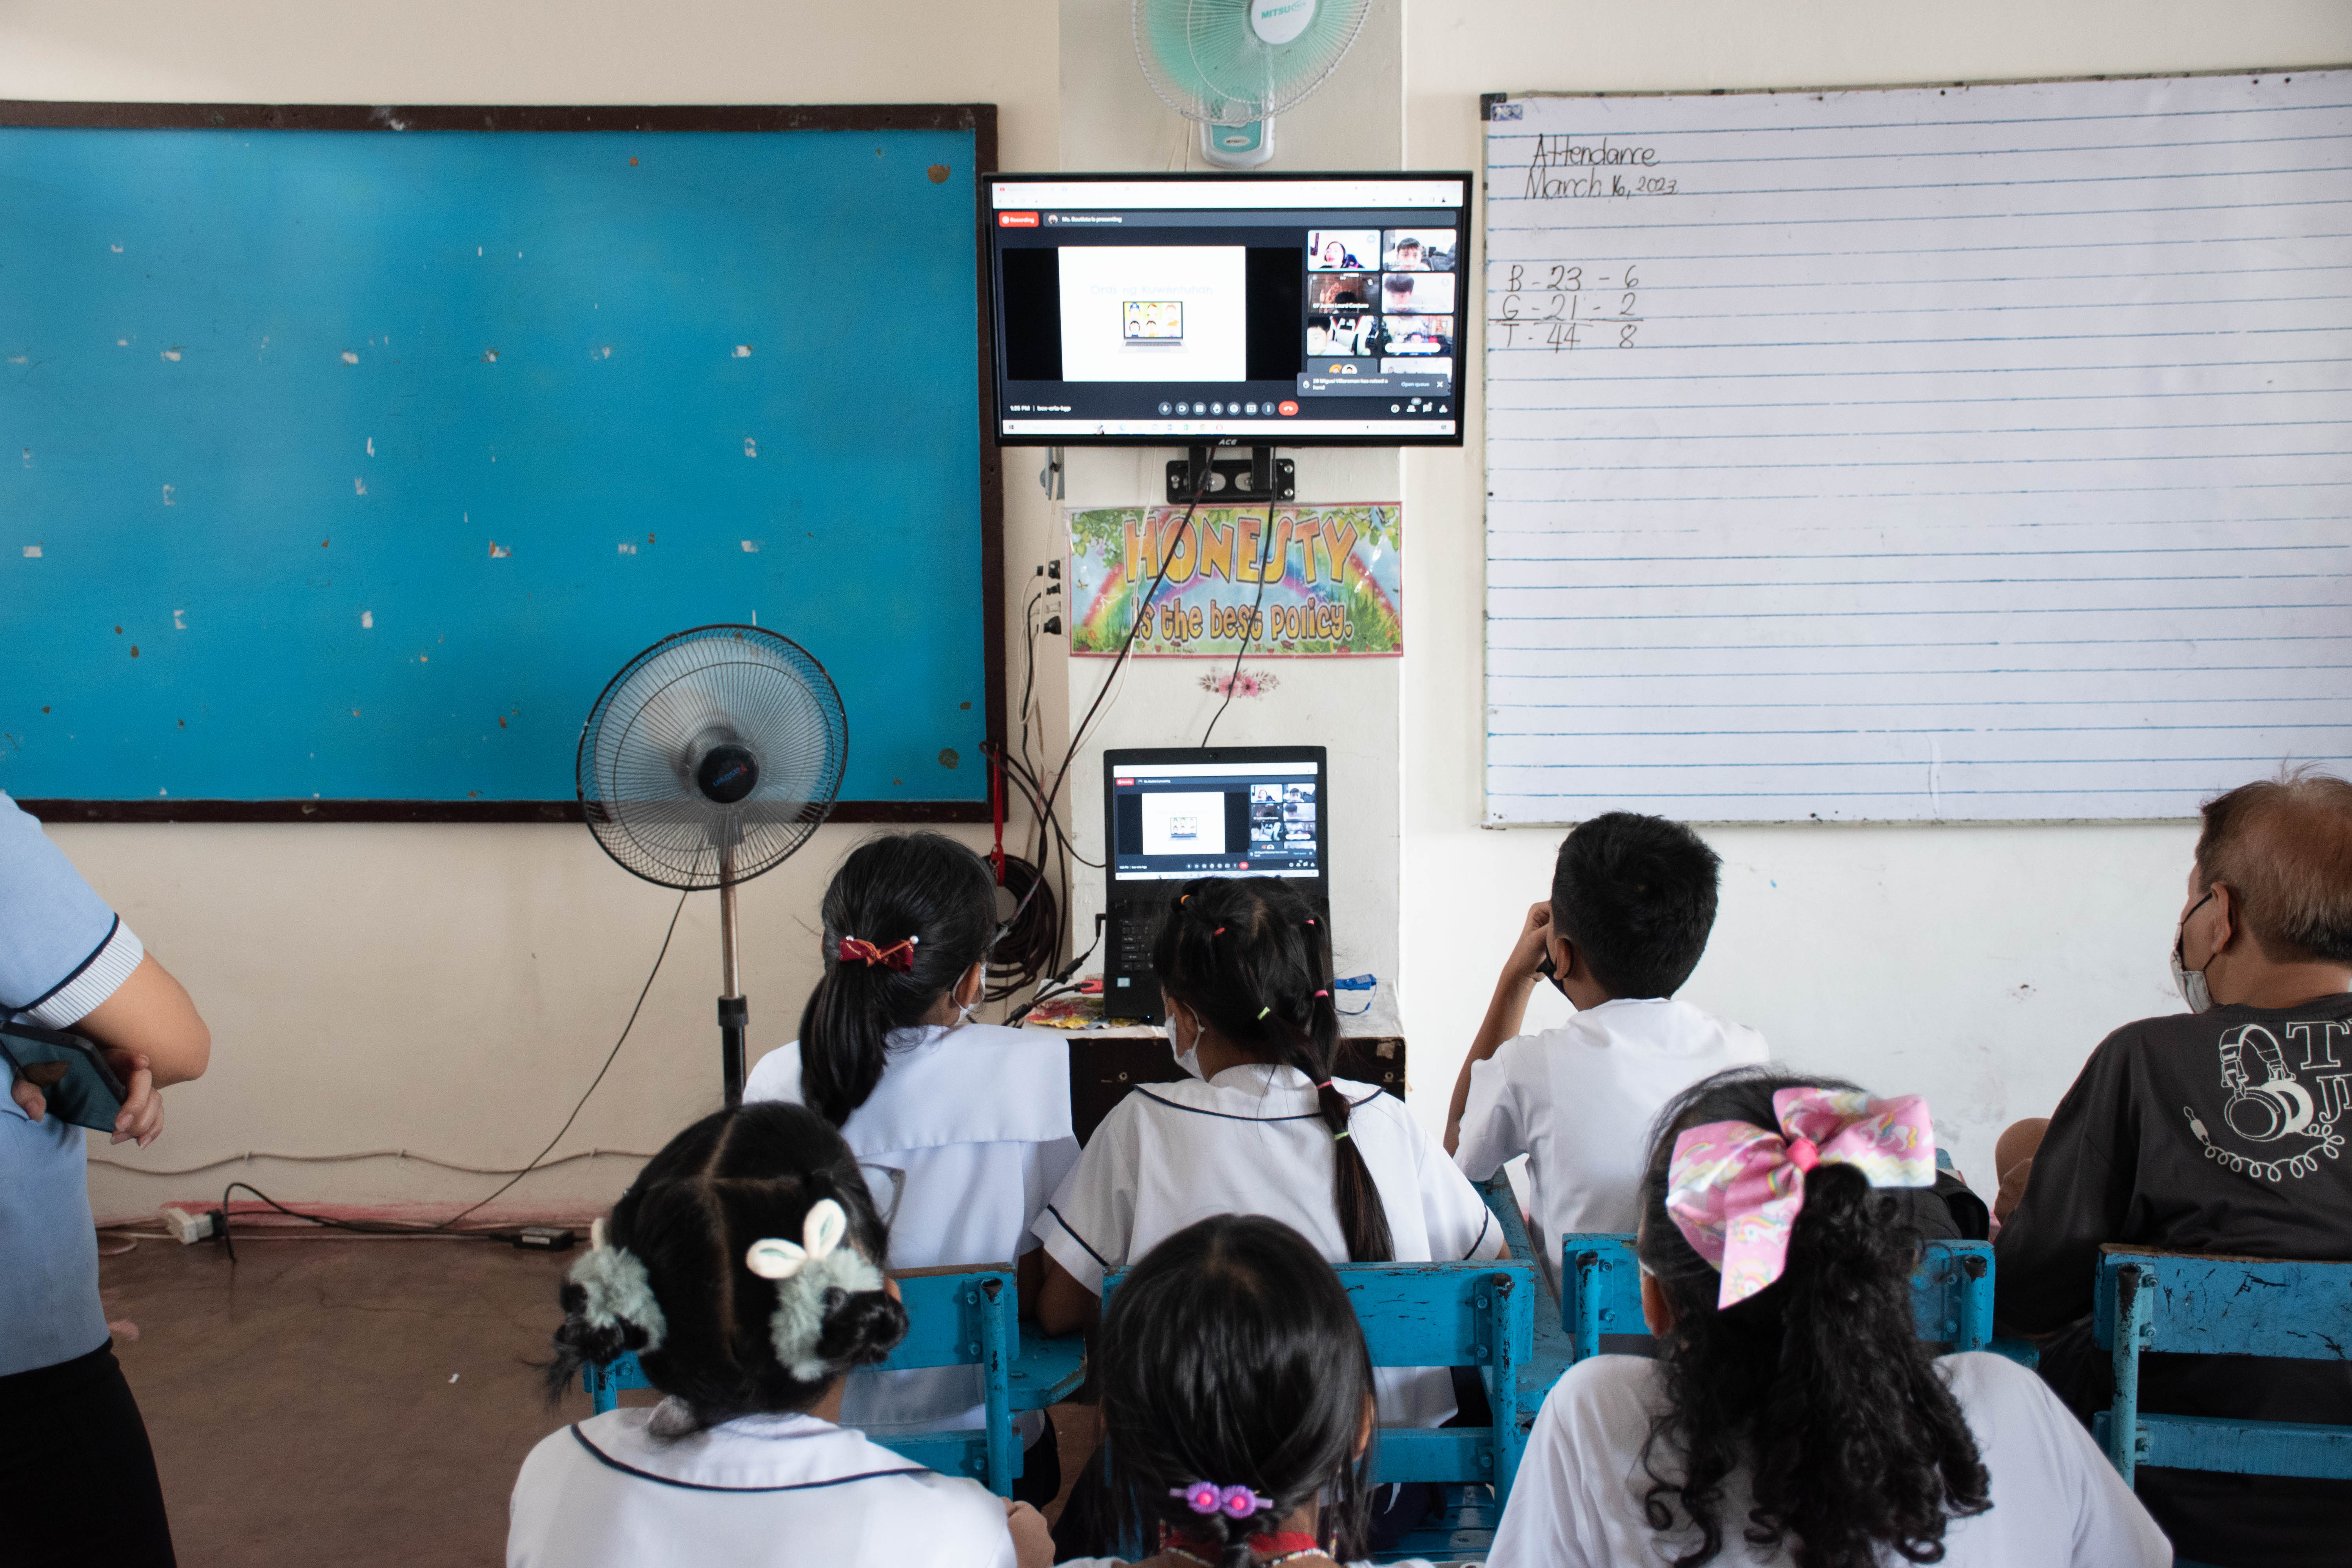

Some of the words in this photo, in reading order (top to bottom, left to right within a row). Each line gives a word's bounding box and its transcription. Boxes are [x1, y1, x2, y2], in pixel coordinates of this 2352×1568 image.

[1533, 133, 1660, 167] Attendance
[1524, 167, 1602, 200] March
[1506, 265, 1524, 292] B
[1546, 265, 1582, 291] 23
[1624, 265, 1639, 288] 6
[1503, 294, 1520, 320] G
[1543, 294, 1577, 321] 21
[1619, 292, 1635, 316] 2
[1501, 324, 1519, 348] T
[1547, 323, 1581, 354] 44
[1619, 324, 1637, 348] 8
[1124, 516, 1358, 584] HONESTY
[1160, 598, 1203, 642] the
[1210, 599, 1263, 640] best
